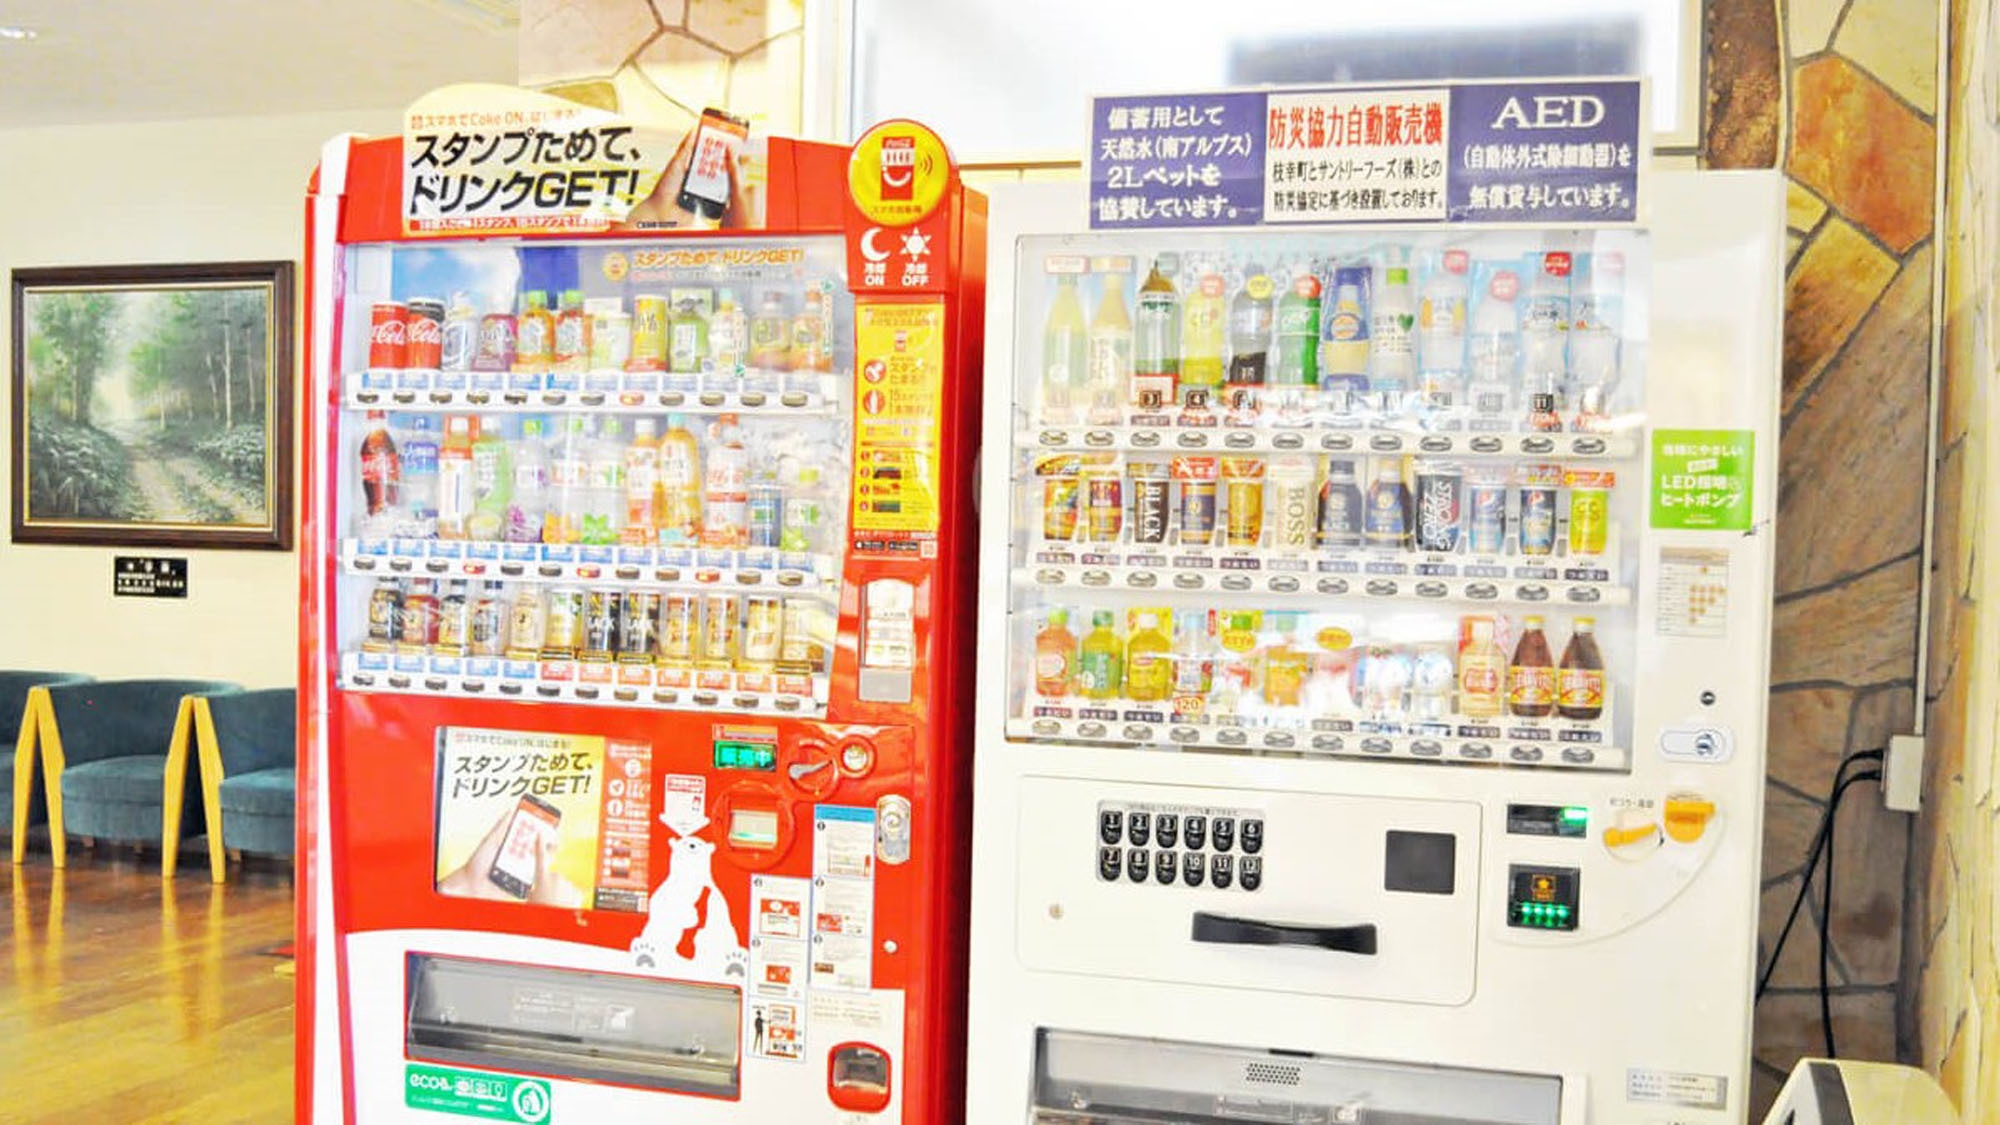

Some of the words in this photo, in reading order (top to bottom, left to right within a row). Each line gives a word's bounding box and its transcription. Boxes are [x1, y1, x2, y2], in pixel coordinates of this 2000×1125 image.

[1108, 106, 1226, 131] 備蓄用として
[1268, 101, 1442, 150] 防災協力自動販売機
[1491, 95, 1606, 130] AED
[411, 126, 641, 168] スタンプためて、
[1107, 163, 1223, 189] 2Lペットを
[410, 169, 640, 215] ドリンクGET!
[864, 274, 885, 286] ON
[901, 274, 929, 286] OFF
[1144, 484, 1161, 539] BLACK
[1289, 487, 1305, 547] BOSS
[454, 752, 594, 775] スタンプためて、
[452, 775, 592, 799] ドリンクGET!
